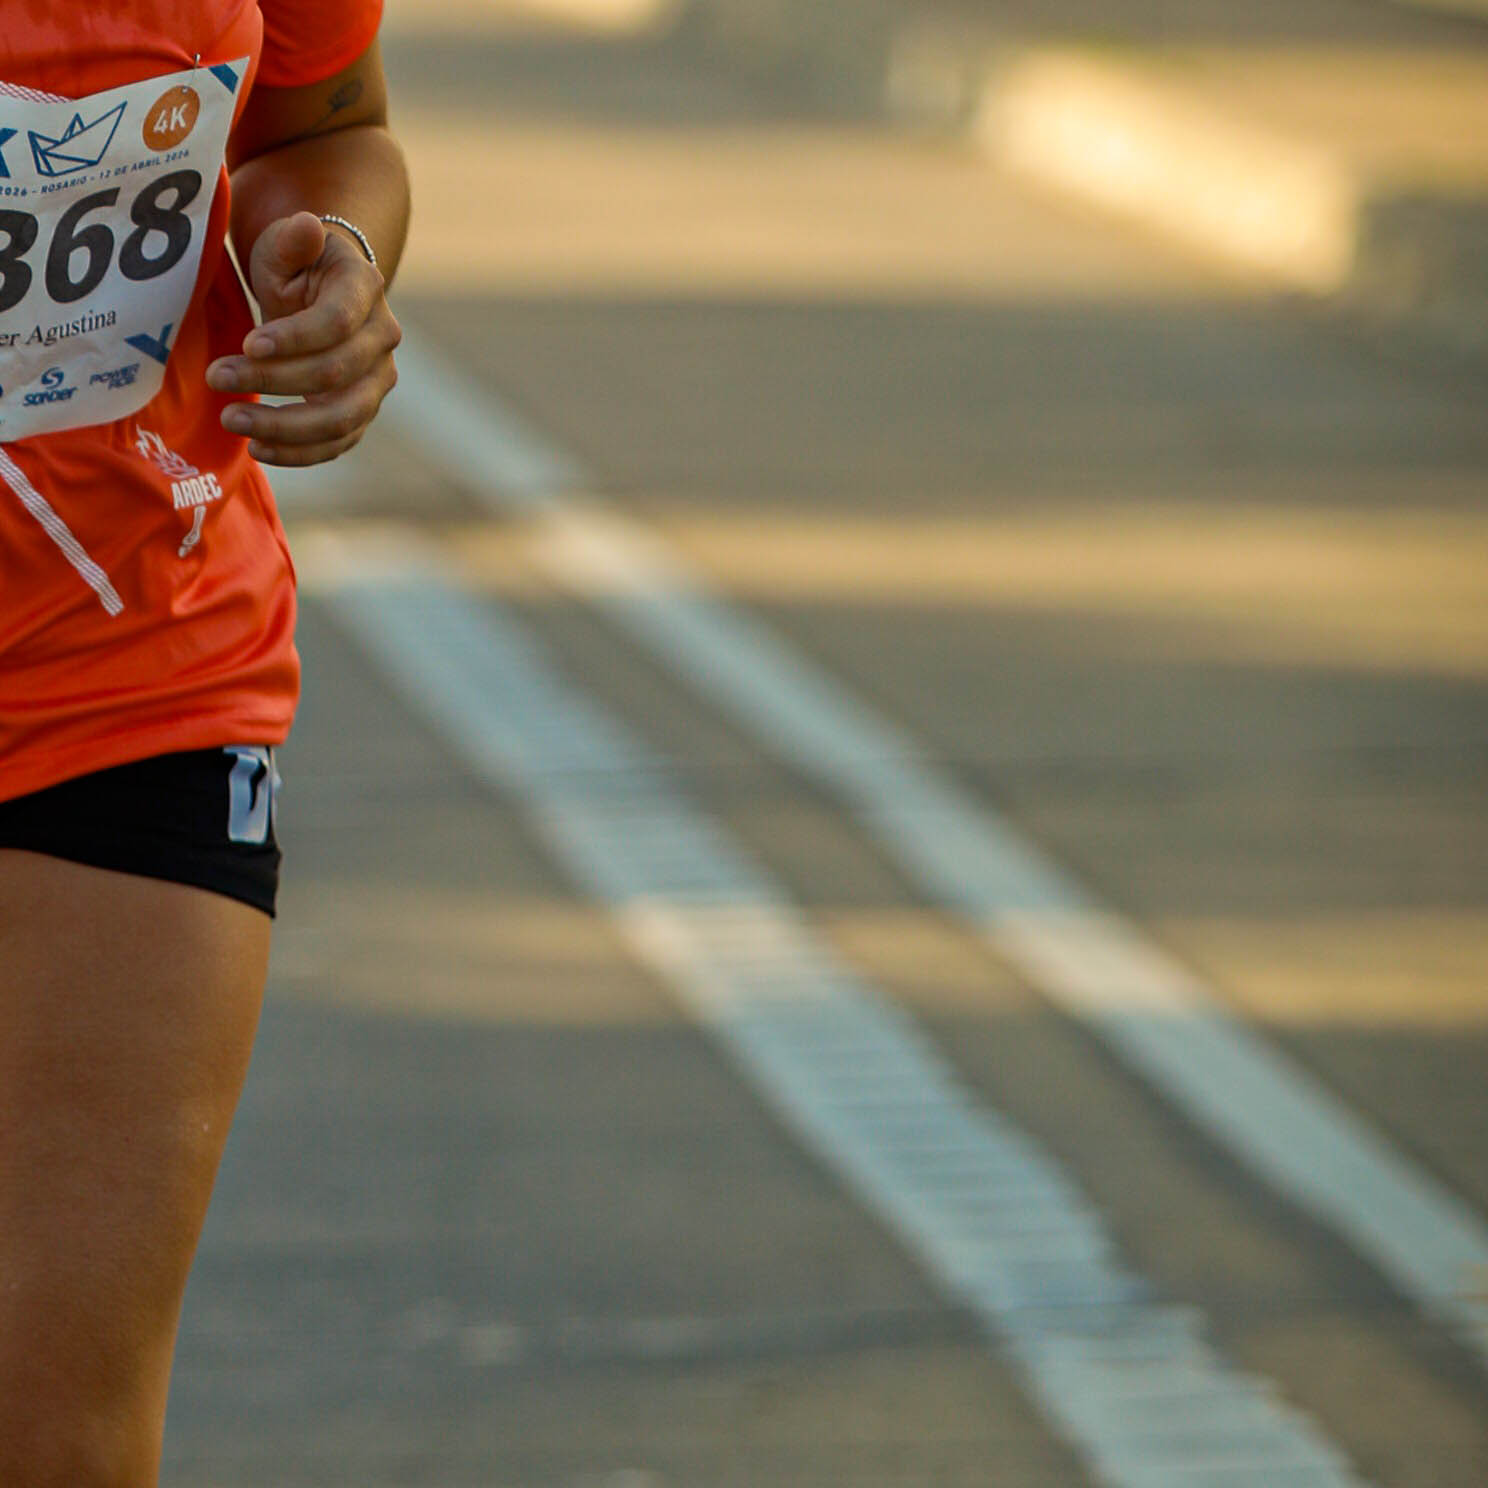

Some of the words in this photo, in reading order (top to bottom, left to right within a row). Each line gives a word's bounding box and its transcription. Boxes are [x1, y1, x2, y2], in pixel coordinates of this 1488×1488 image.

[153, 102, 189, 134] 4K
[40, 175, 87, 194] ROSARIO
[114, 165, 128, 176] DE
[130, 159, 160, 172] ABRIL
[25, 309, 117, 347] Agustina
